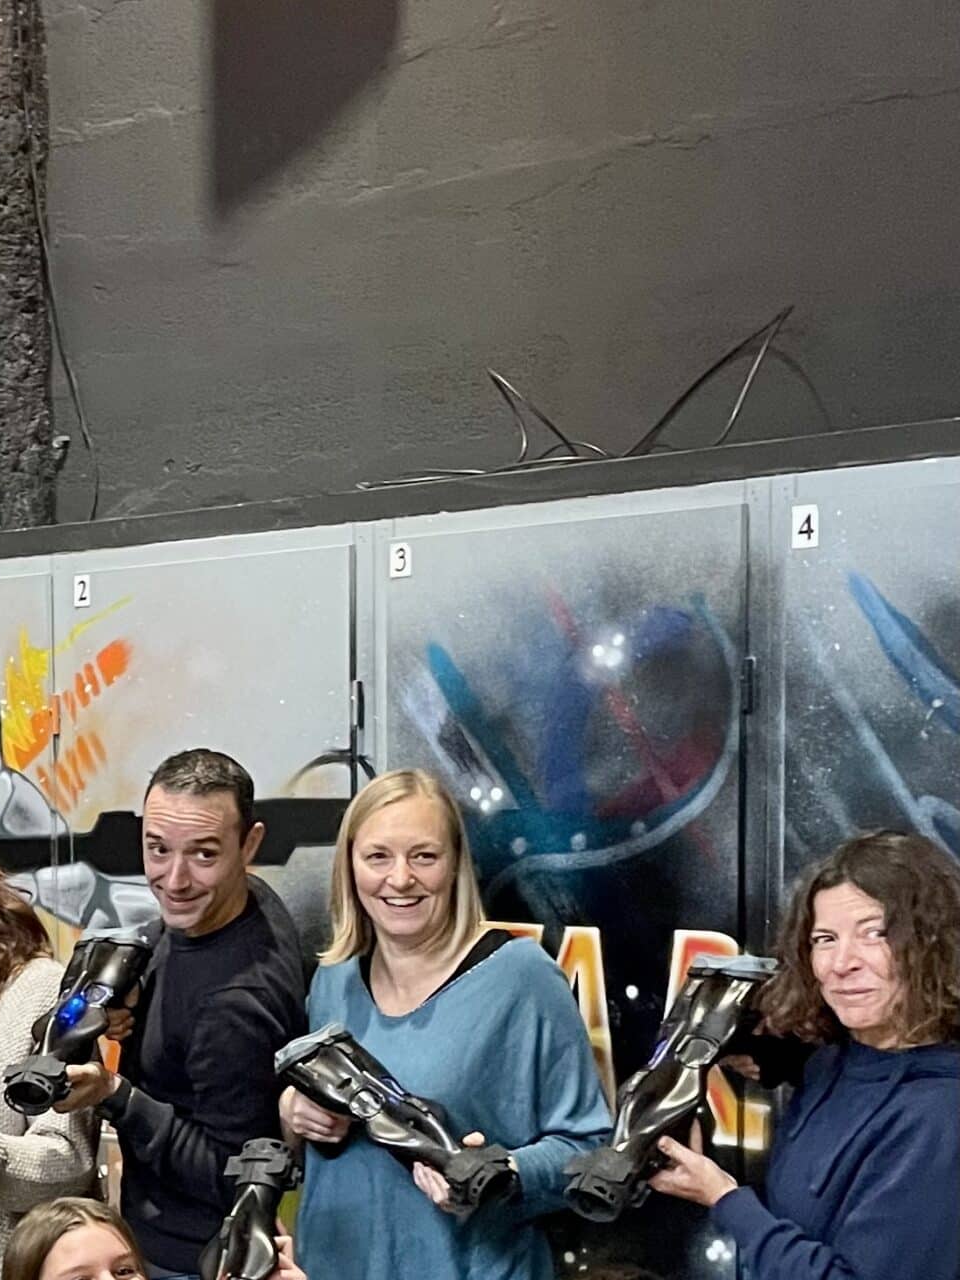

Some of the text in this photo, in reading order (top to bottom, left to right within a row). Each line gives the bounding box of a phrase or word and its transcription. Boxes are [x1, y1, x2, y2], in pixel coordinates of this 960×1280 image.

[797, 513, 815, 541] 4
[394, 547, 408, 573] 3
[77, 580, 88, 601] 2
